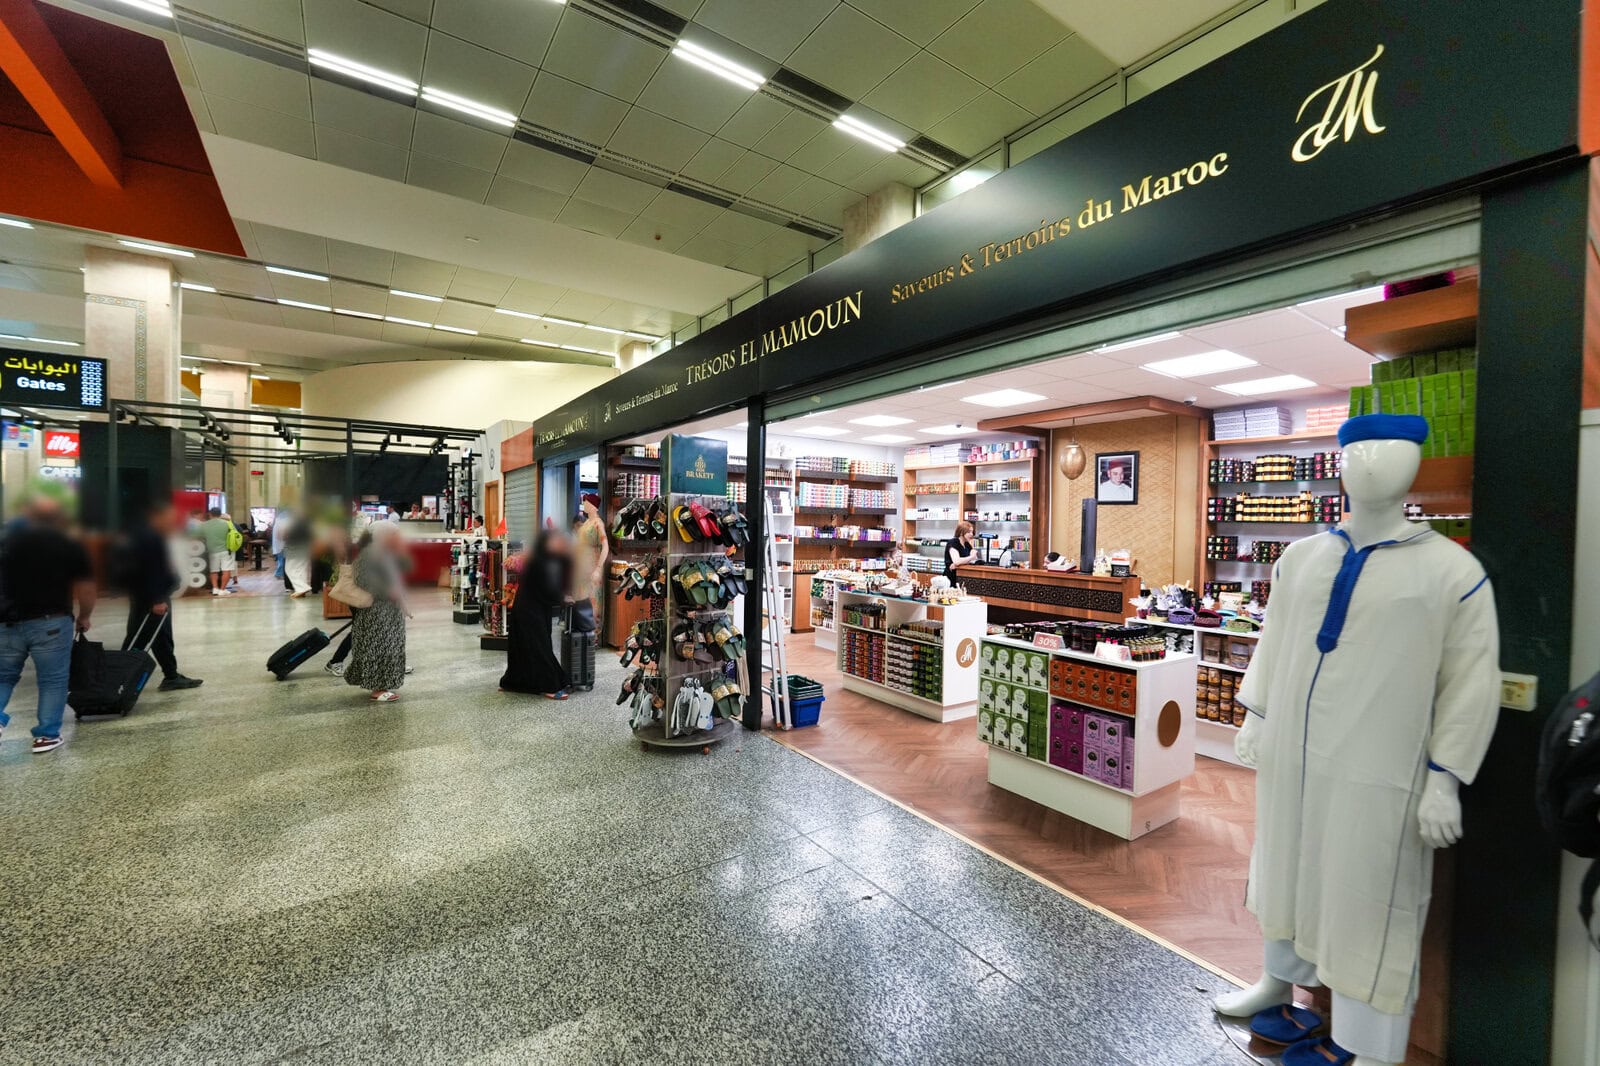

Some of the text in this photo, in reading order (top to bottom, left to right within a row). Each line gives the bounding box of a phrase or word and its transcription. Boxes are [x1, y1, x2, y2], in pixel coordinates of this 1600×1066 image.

[890, 152, 1230, 304] Saveurs & Terroirs du Maroc
[740, 340, 757, 366] EL
[760, 290, 863, 357] MAMOUN
[4, 357, 77, 376] البوابات
[16, 376, 66, 391] Gates
[47, 435, 78, 454] illy
[685, 470, 714, 479] BRAKETT
[1038, 636, 1057, 648] 30%
